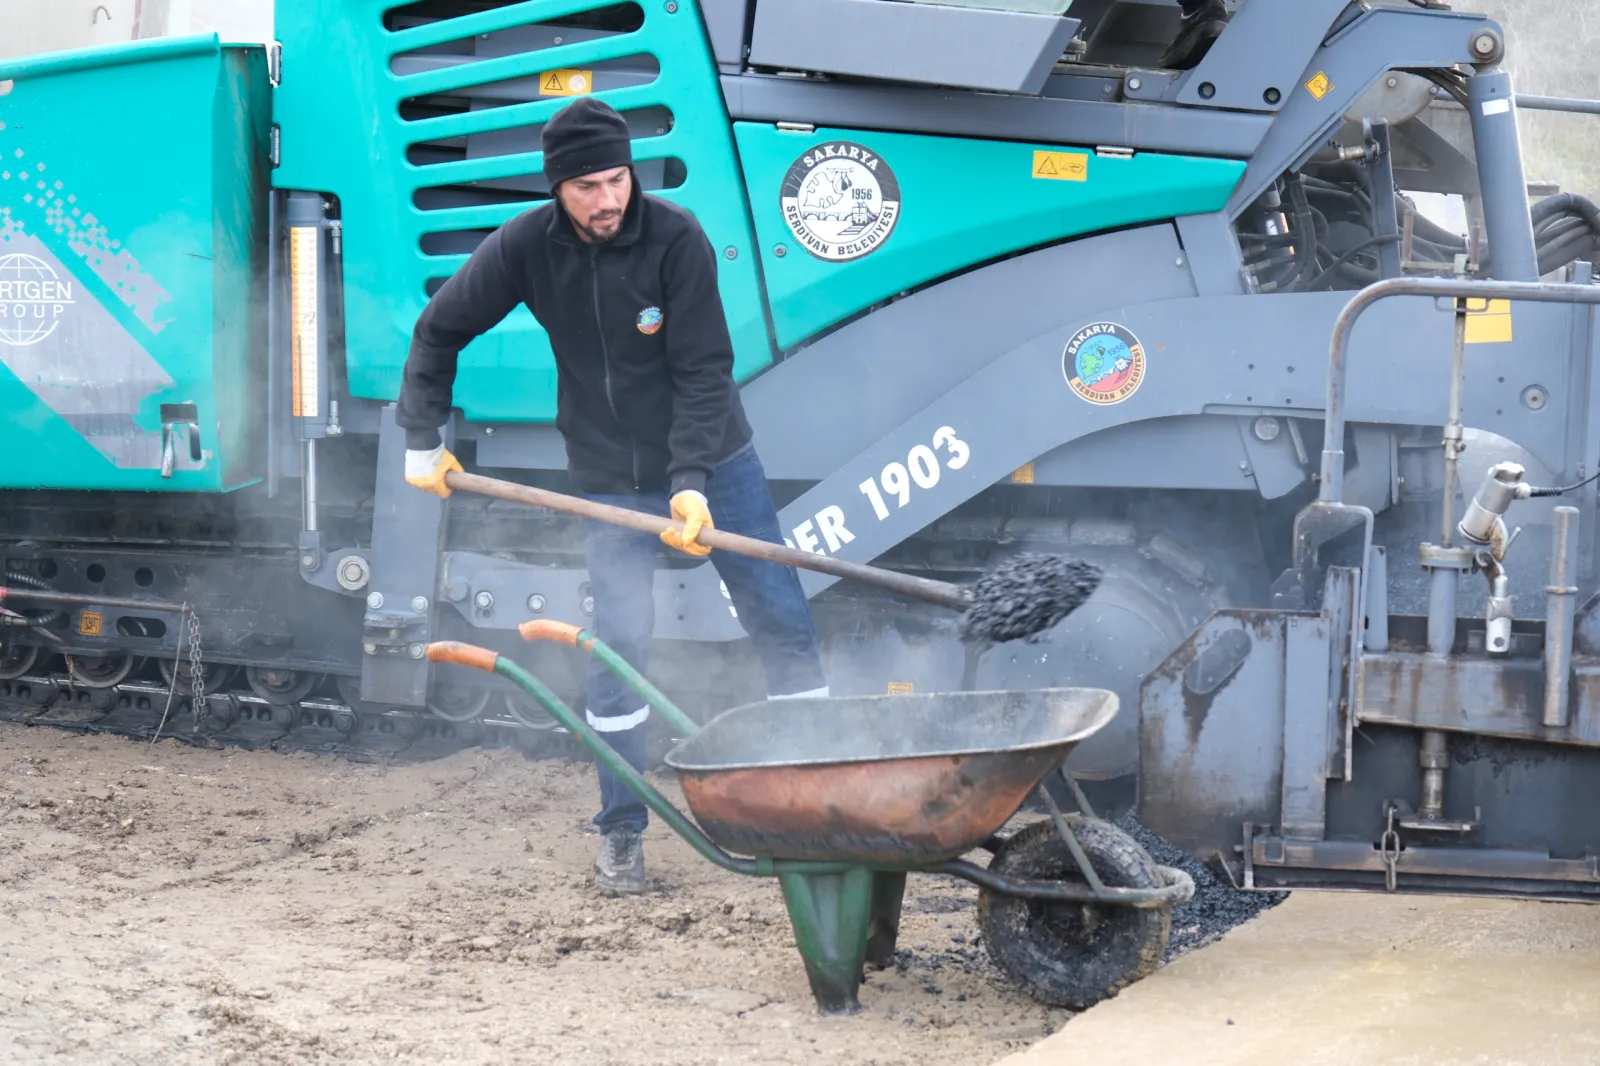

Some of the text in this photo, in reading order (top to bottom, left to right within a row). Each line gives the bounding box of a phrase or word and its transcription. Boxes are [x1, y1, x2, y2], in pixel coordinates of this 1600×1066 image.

[803, 144, 879, 171] SAKARYA
[851, 188, 873, 200] 1956
[1068, 324, 1116, 355] SAKARYA
[858, 425, 970, 521] 1903
